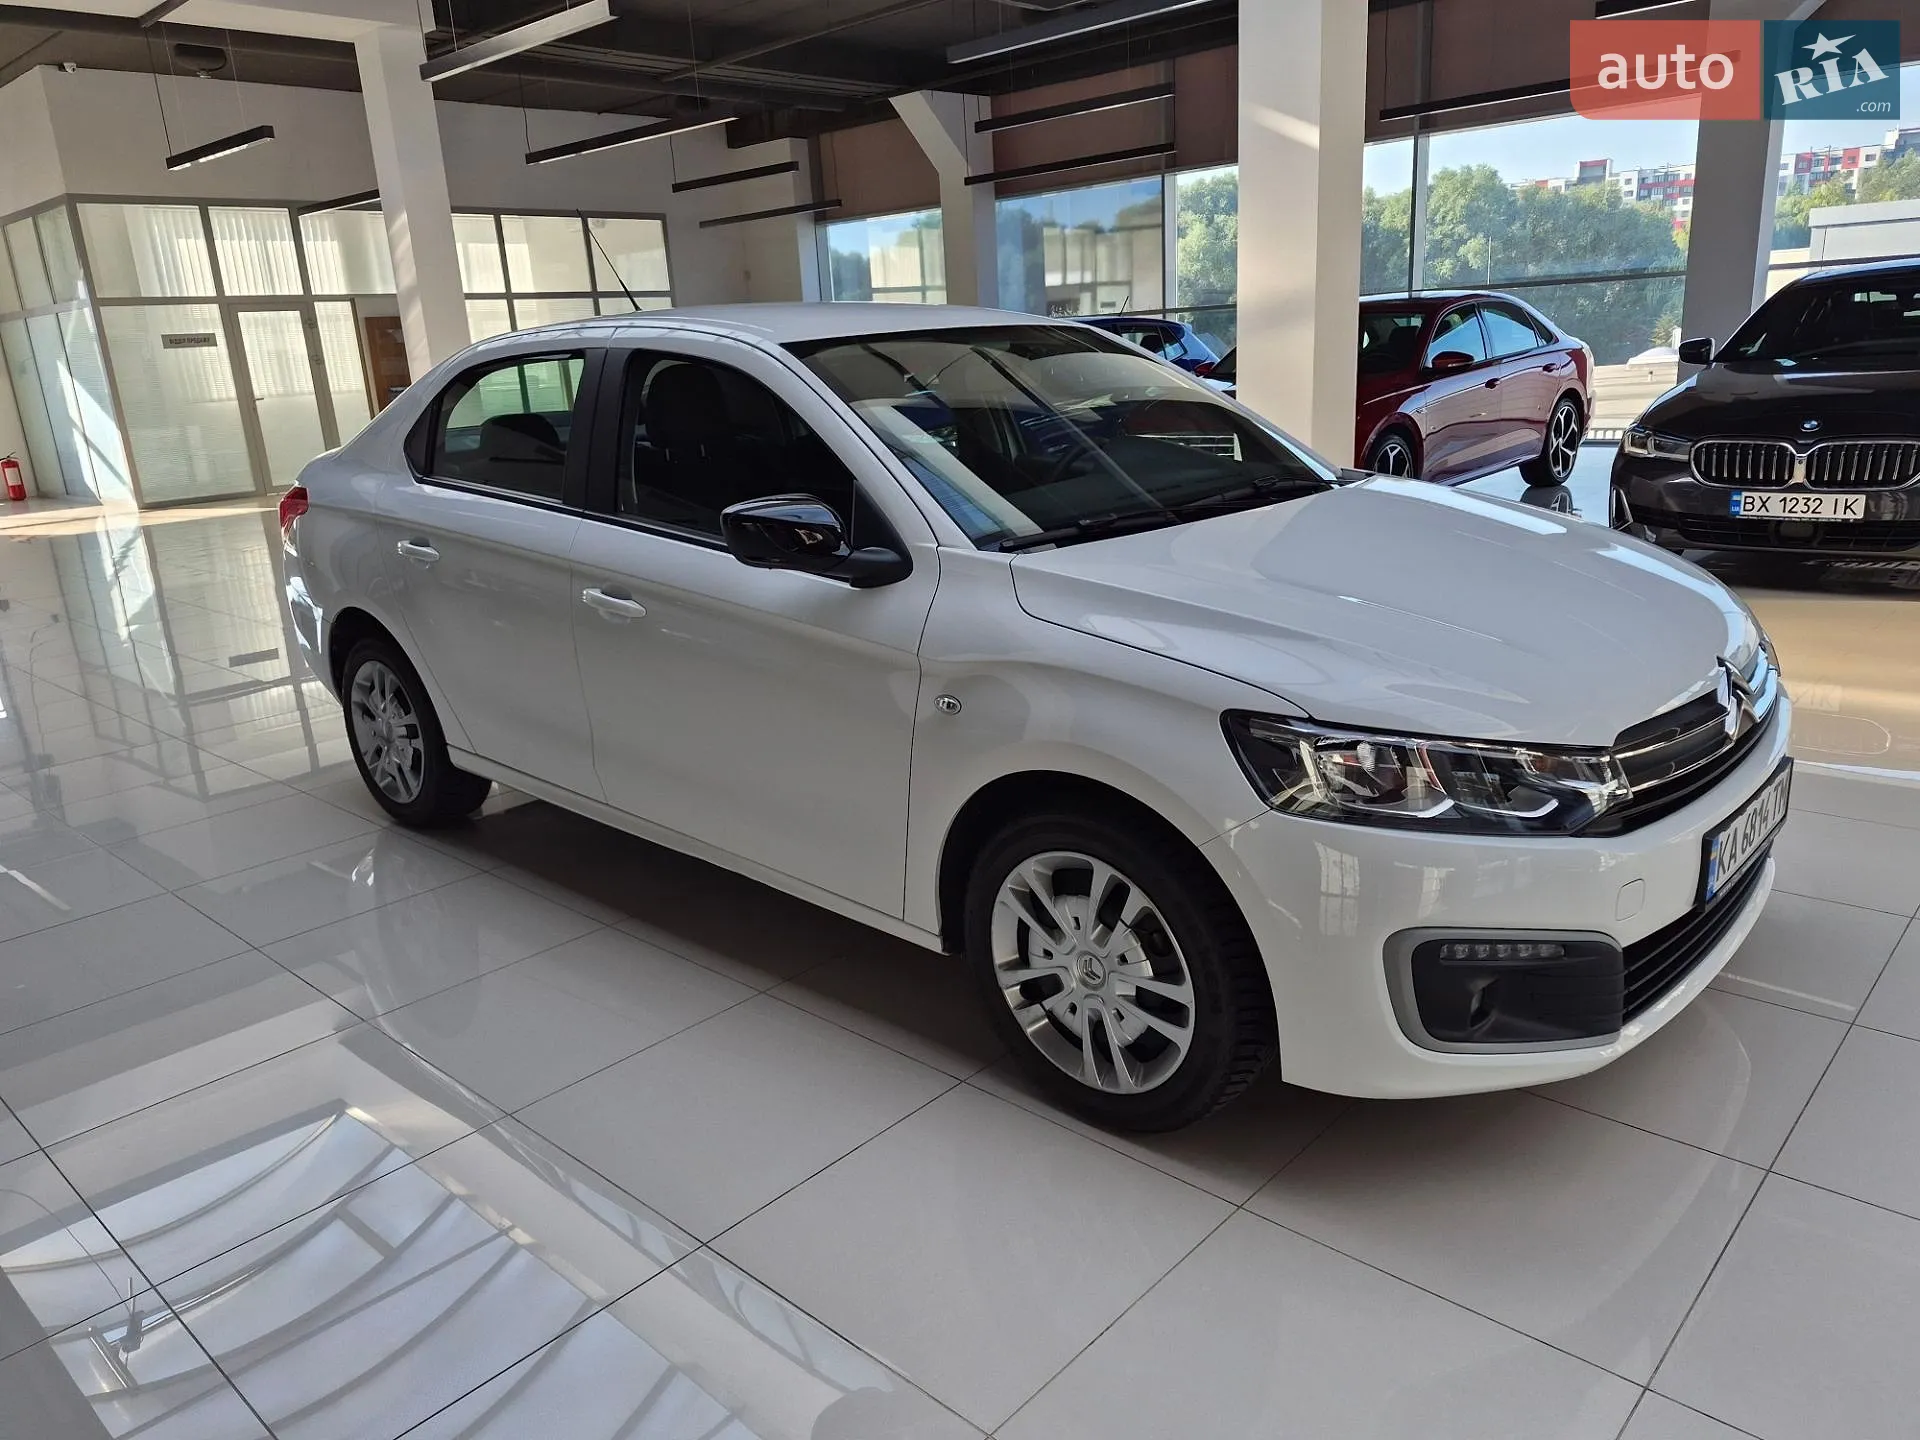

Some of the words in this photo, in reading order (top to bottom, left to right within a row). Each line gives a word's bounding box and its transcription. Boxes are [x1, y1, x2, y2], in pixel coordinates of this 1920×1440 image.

[1743, 495, 1771, 513] BX
[1779, 496, 1823, 514] 1232
[1833, 498, 1859, 515] IK
[1717, 827, 1738, 881] KA
